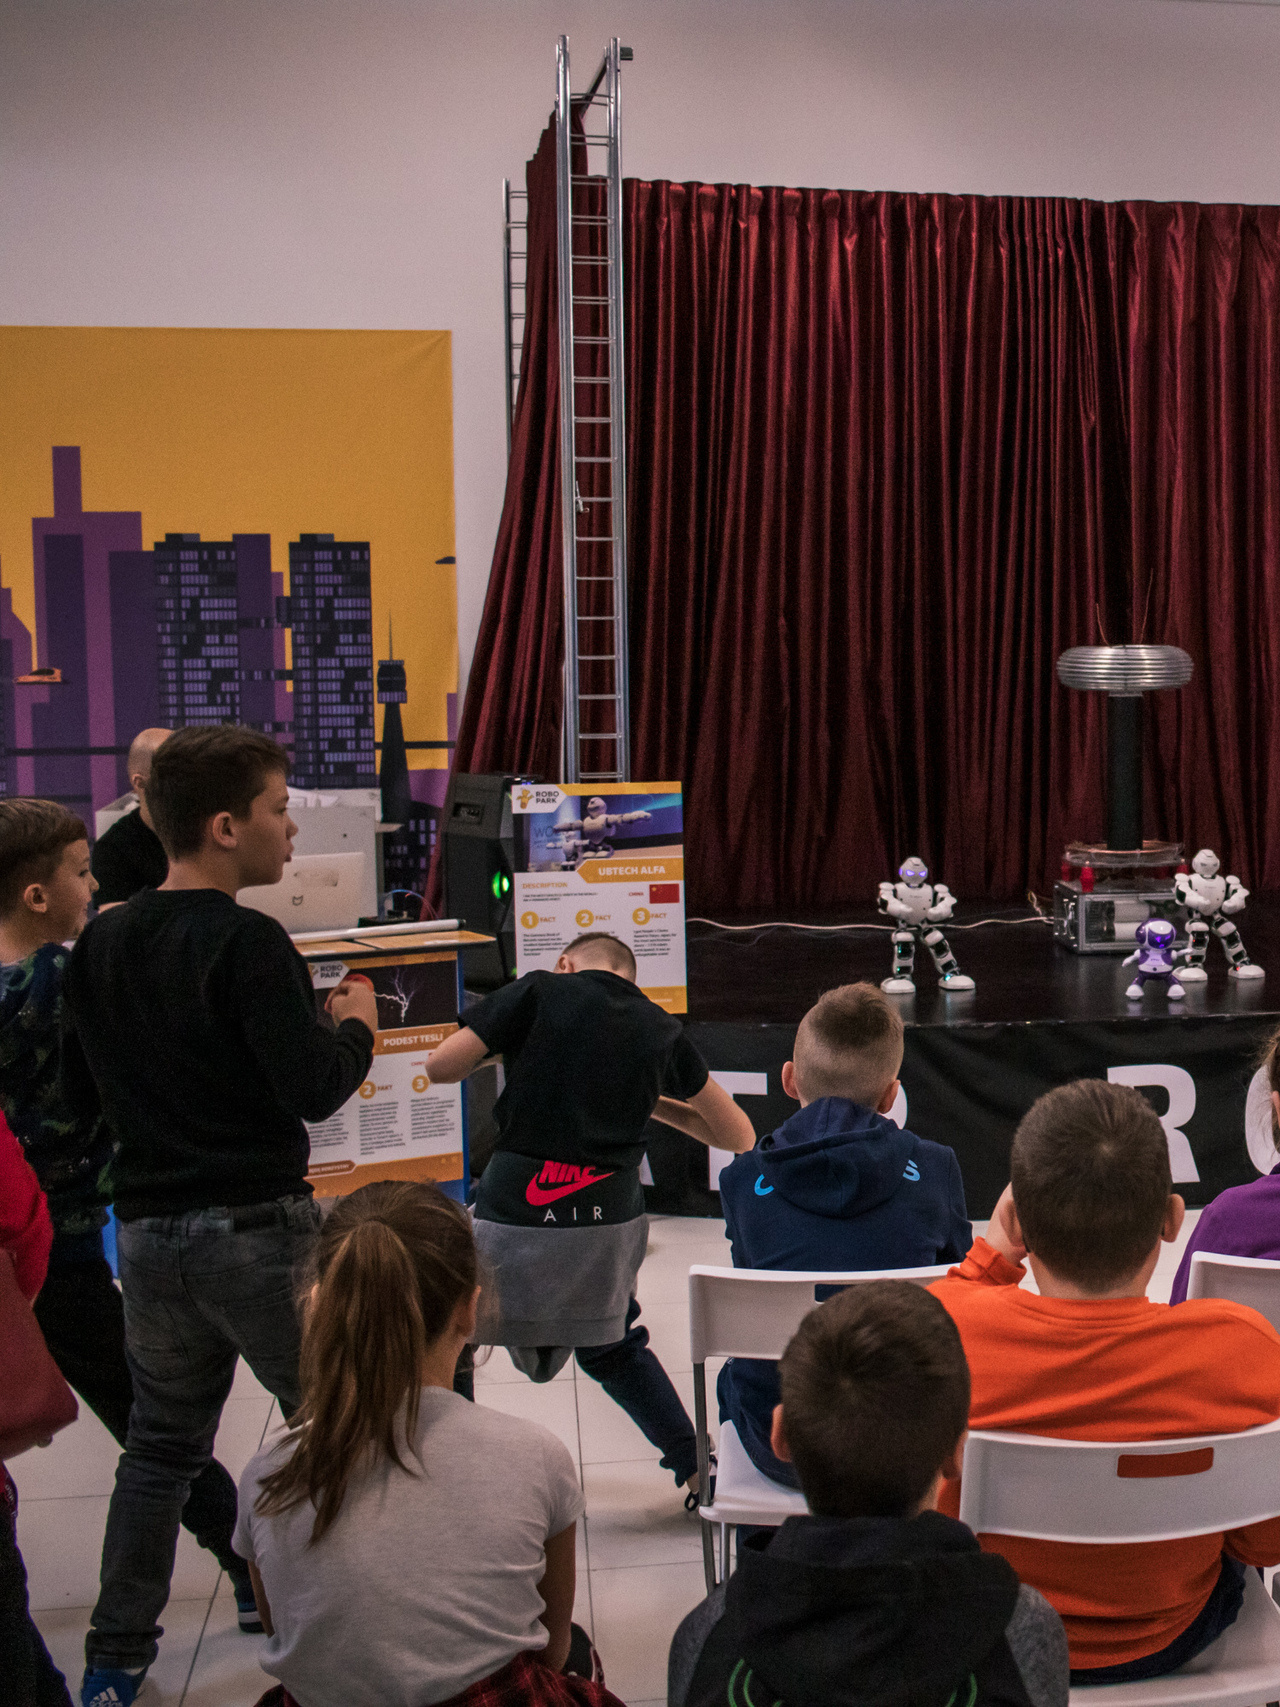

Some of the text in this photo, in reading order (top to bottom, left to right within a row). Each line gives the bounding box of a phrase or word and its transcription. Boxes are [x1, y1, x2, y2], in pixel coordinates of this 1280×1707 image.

[598, 866, 666, 876] UBTECH ALFA
[526, 915, 533, 925] 1
[580, 913, 590, 924] 2
[637, 911, 645, 922] 3
[384, 1034, 444, 1047] PODEST TESLI
[416, 1078, 424, 1089] 3
[363, 1084, 372, 1095] 2
[538, 1160, 597, 1184] NIKE
[543, 1206, 603, 1222] AIR
